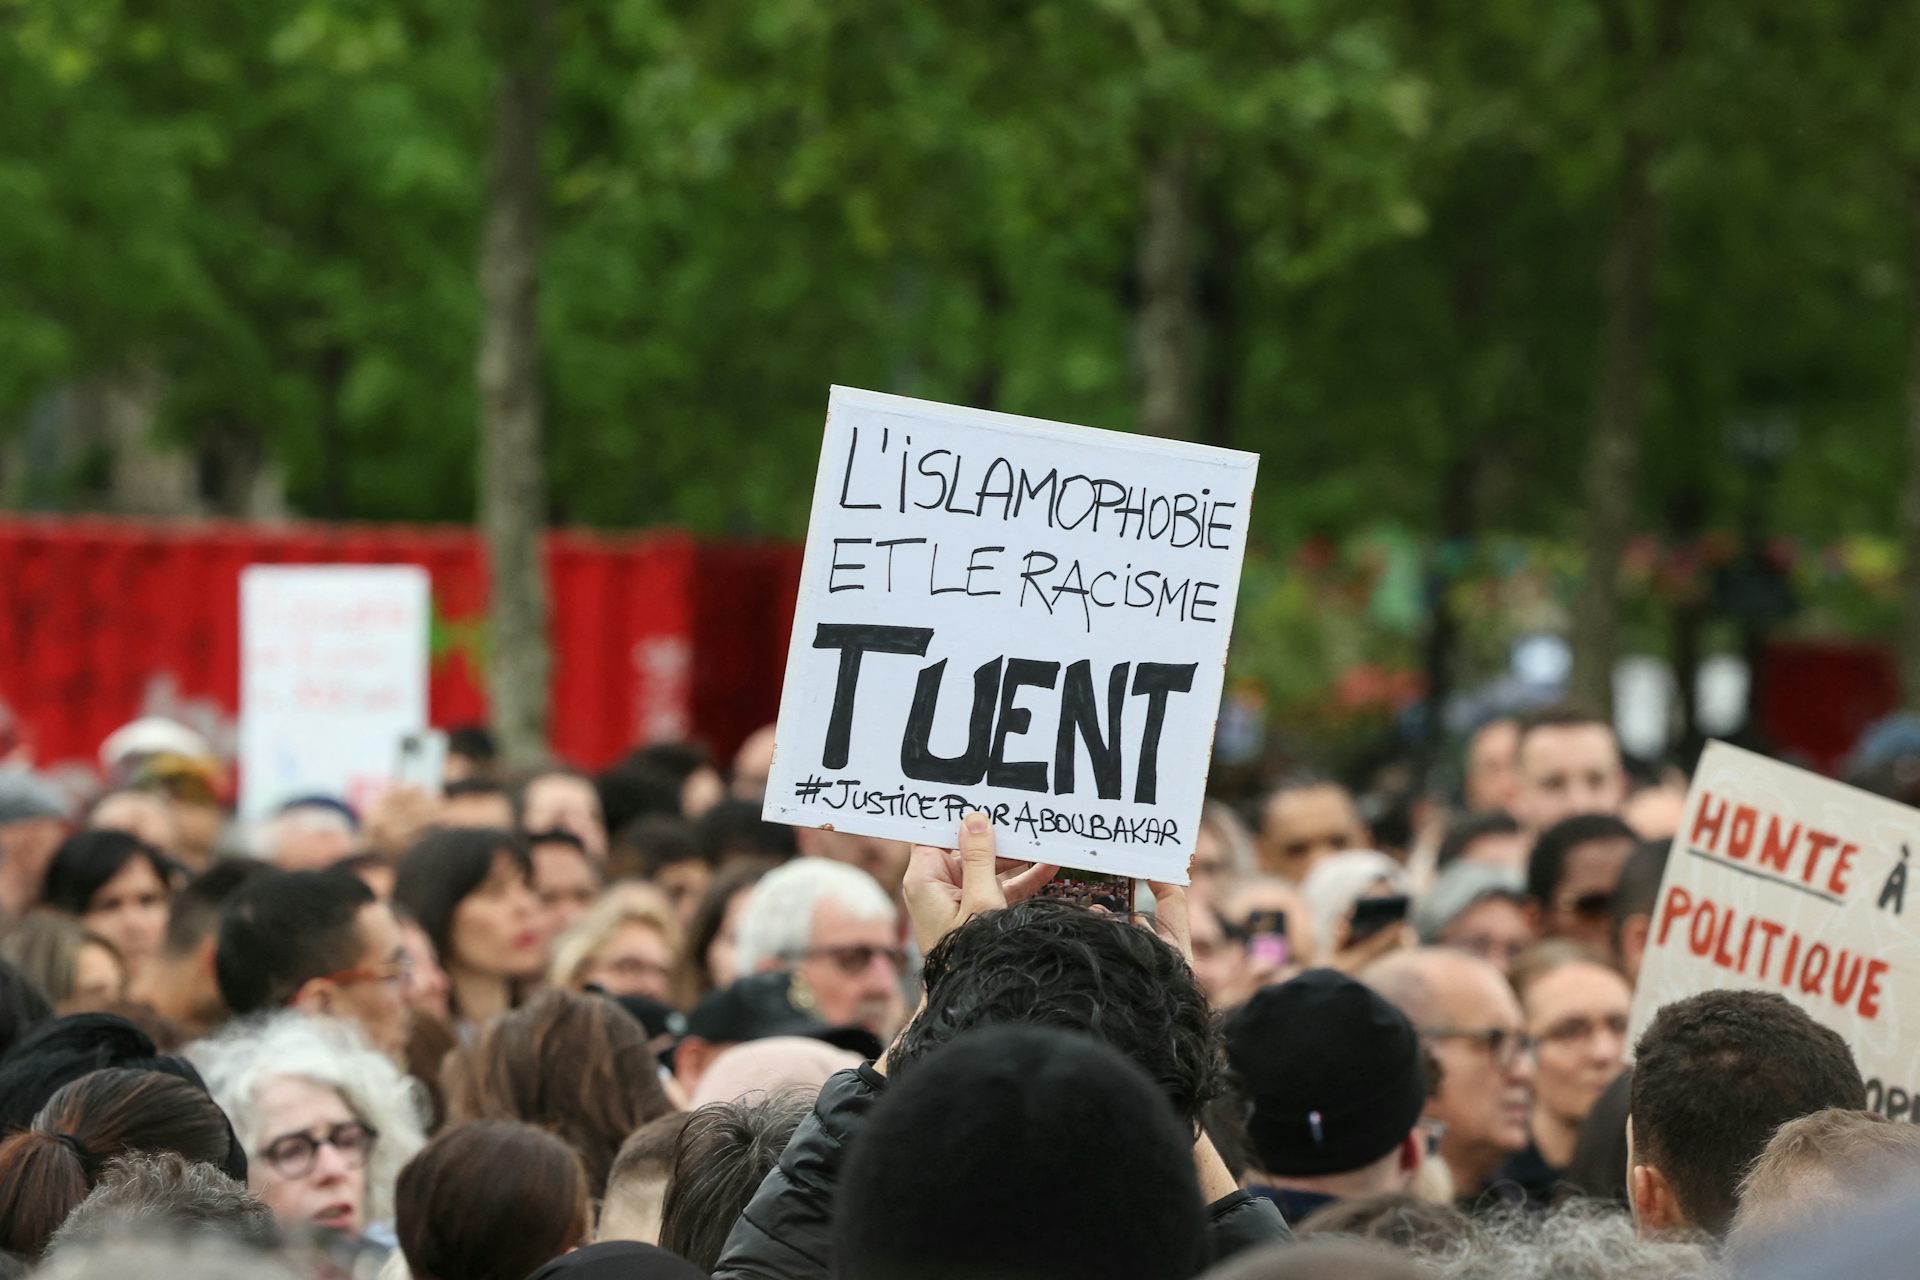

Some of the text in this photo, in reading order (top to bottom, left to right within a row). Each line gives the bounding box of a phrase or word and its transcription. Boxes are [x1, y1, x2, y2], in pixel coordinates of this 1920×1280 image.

[829, 537, 927, 594] ET
[930, 543, 1006, 597] LE
[813, 623, 1198, 805] TUENT
[1690, 792, 1910, 915] HONTE À
[1658, 886, 1890, 1020] POLITIQUE
